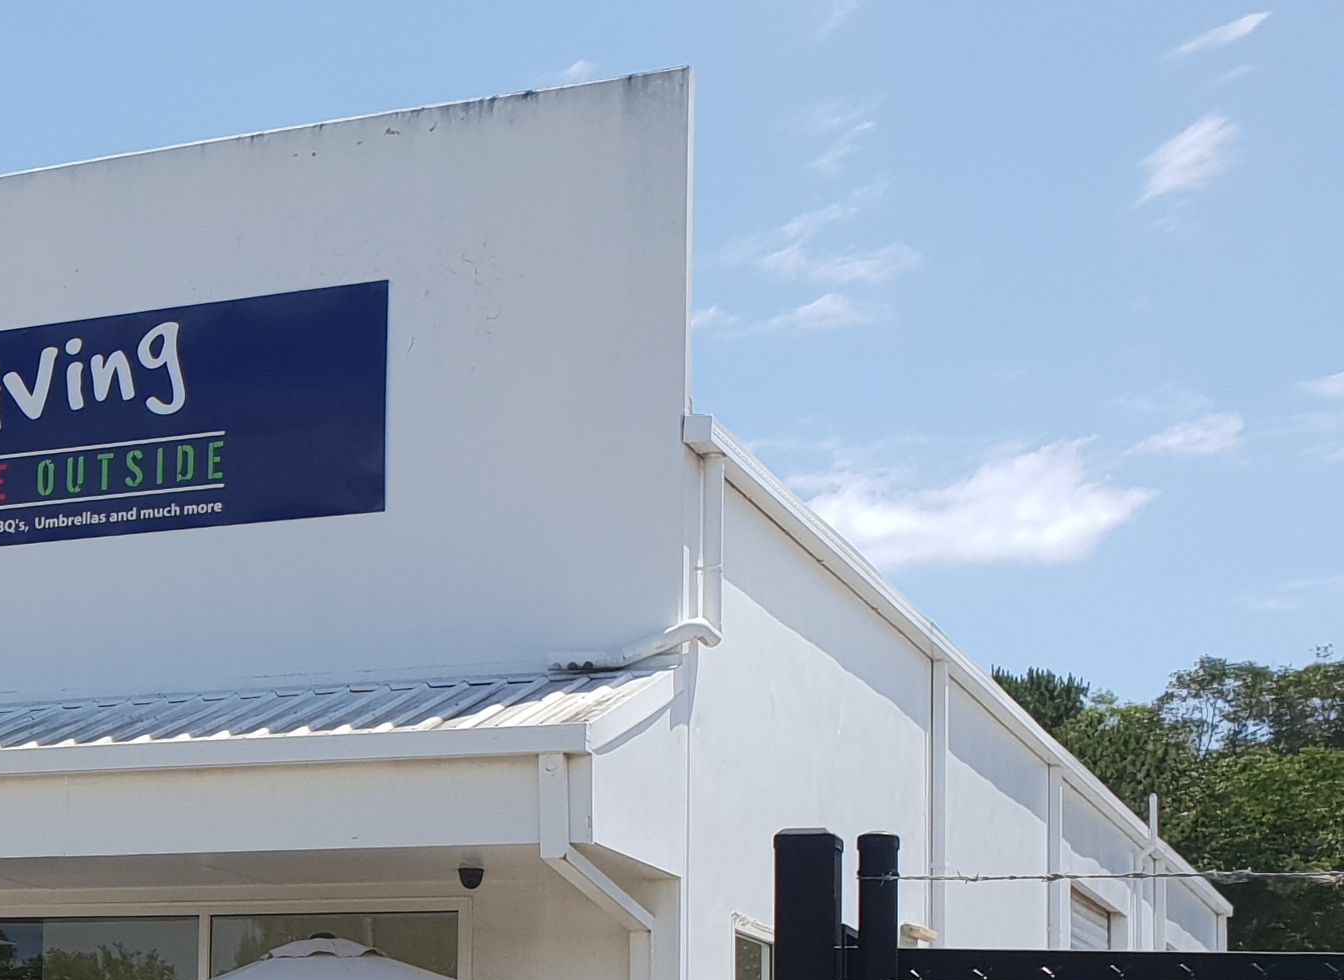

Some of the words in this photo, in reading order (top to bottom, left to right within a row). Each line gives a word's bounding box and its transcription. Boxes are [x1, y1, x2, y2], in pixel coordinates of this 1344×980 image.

[36, 440, 224, 497] OUTSIDE
[34, 509, 106, 531] Umbrellas
[109, 508, 137, 524] and
[140, 503, 180, 521] much
[183, 501, 223, 517] more
